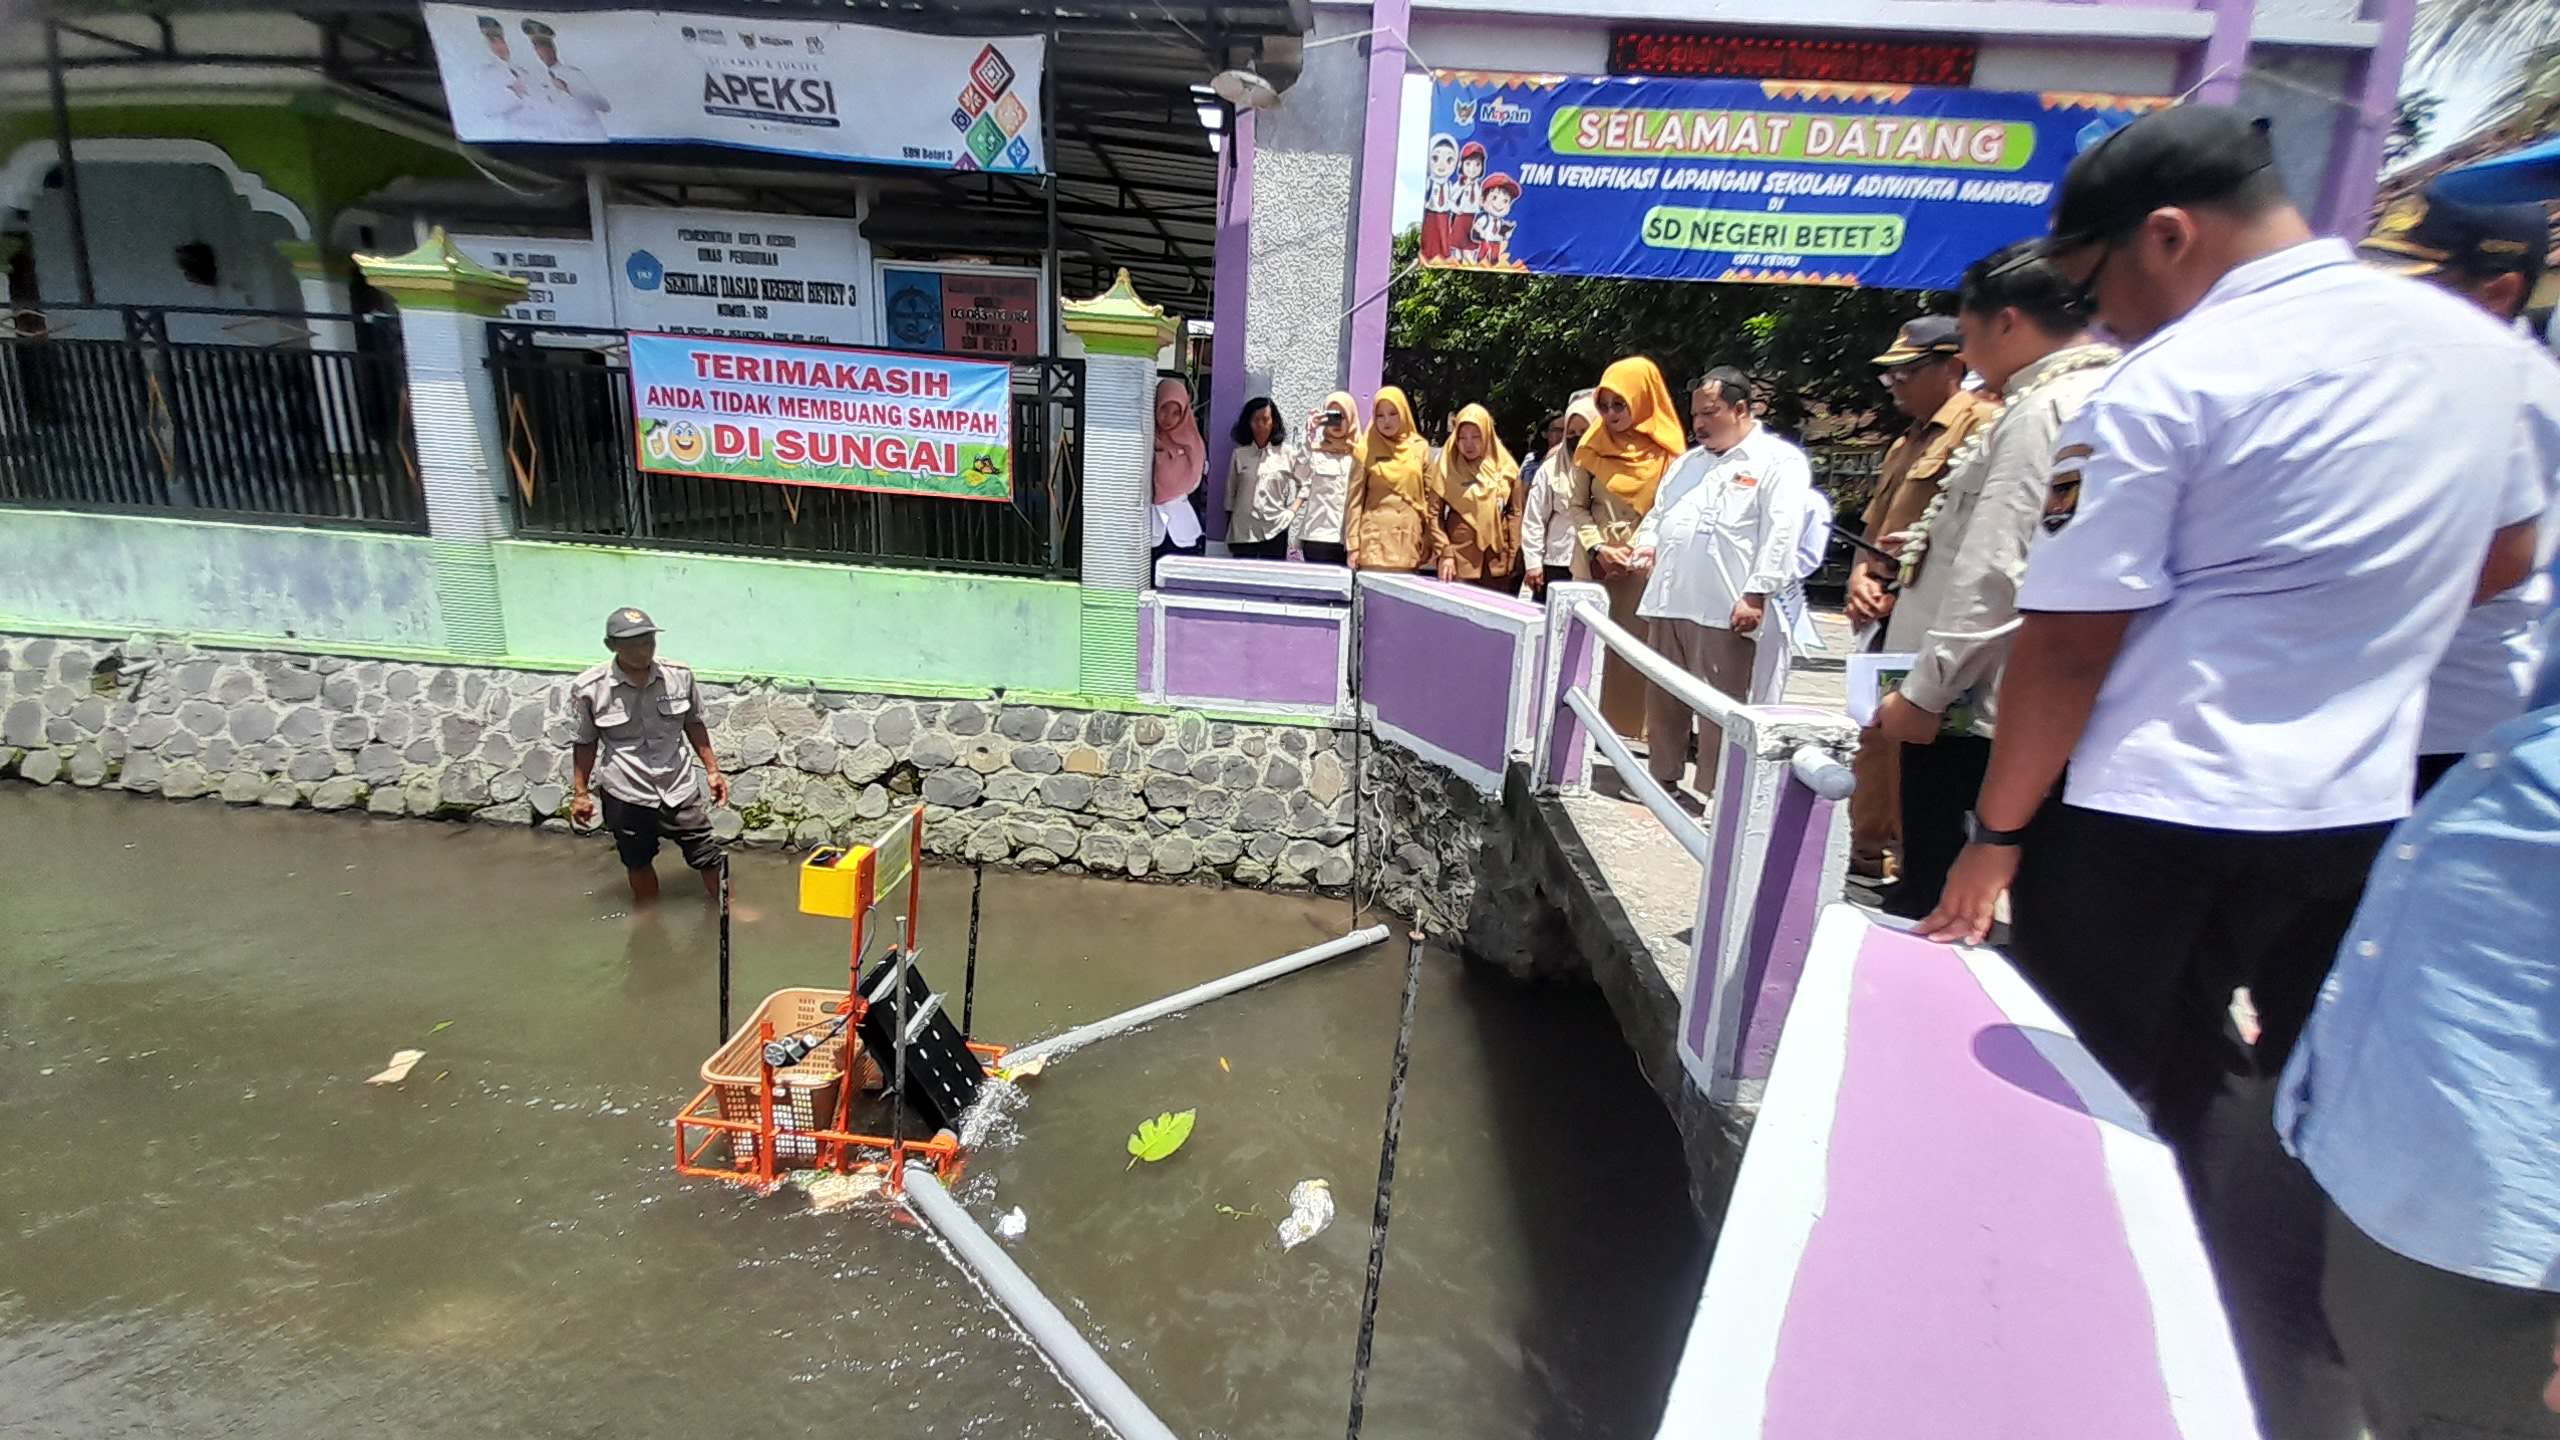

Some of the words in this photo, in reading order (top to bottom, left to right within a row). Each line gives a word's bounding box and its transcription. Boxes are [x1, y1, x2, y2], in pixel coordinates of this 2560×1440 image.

[704, 72, 837, 115] APEKSI
[1481, 104, 1530, 124] Mapan
[1577, 112, 1790, 155] SELAMAT
[1803, 117, 2007, 165] DATANG
[1519, 162, 1553, 186] TIM
[1557, 164, 1657, 190] VERIFIKASI
[1660, 168, 1762, 194] LAPANGAN
[1762, 170, 1851, 197] SEKOLAH
[1767, 197, 1787, 211] DI
[1648, 216, 1682, 242] SD
[1689, 219, 1789, 246] NEGERI
[1794, 223, 1877, 248] BETET
[1880, 225, 1897, 248] 3
[720, 274, 760, 300] DASAR
[760, 278, 806, 304] NEGERI
[806, 281, 846, 307] BETET
[847, 283, 858, 308] 3
[691, 352, 949, 397] TERIMAKASIH
[647, 386, 705, 409] ANDA
[710, 391, 773, 415] TIDAK
[777, 397, 901, 426] MEMBUANG
[907, 408, 998, 434] SAMPAH
[713, 424, 761, 458] DI
[775, 430, 957, 474] SUNGAI
